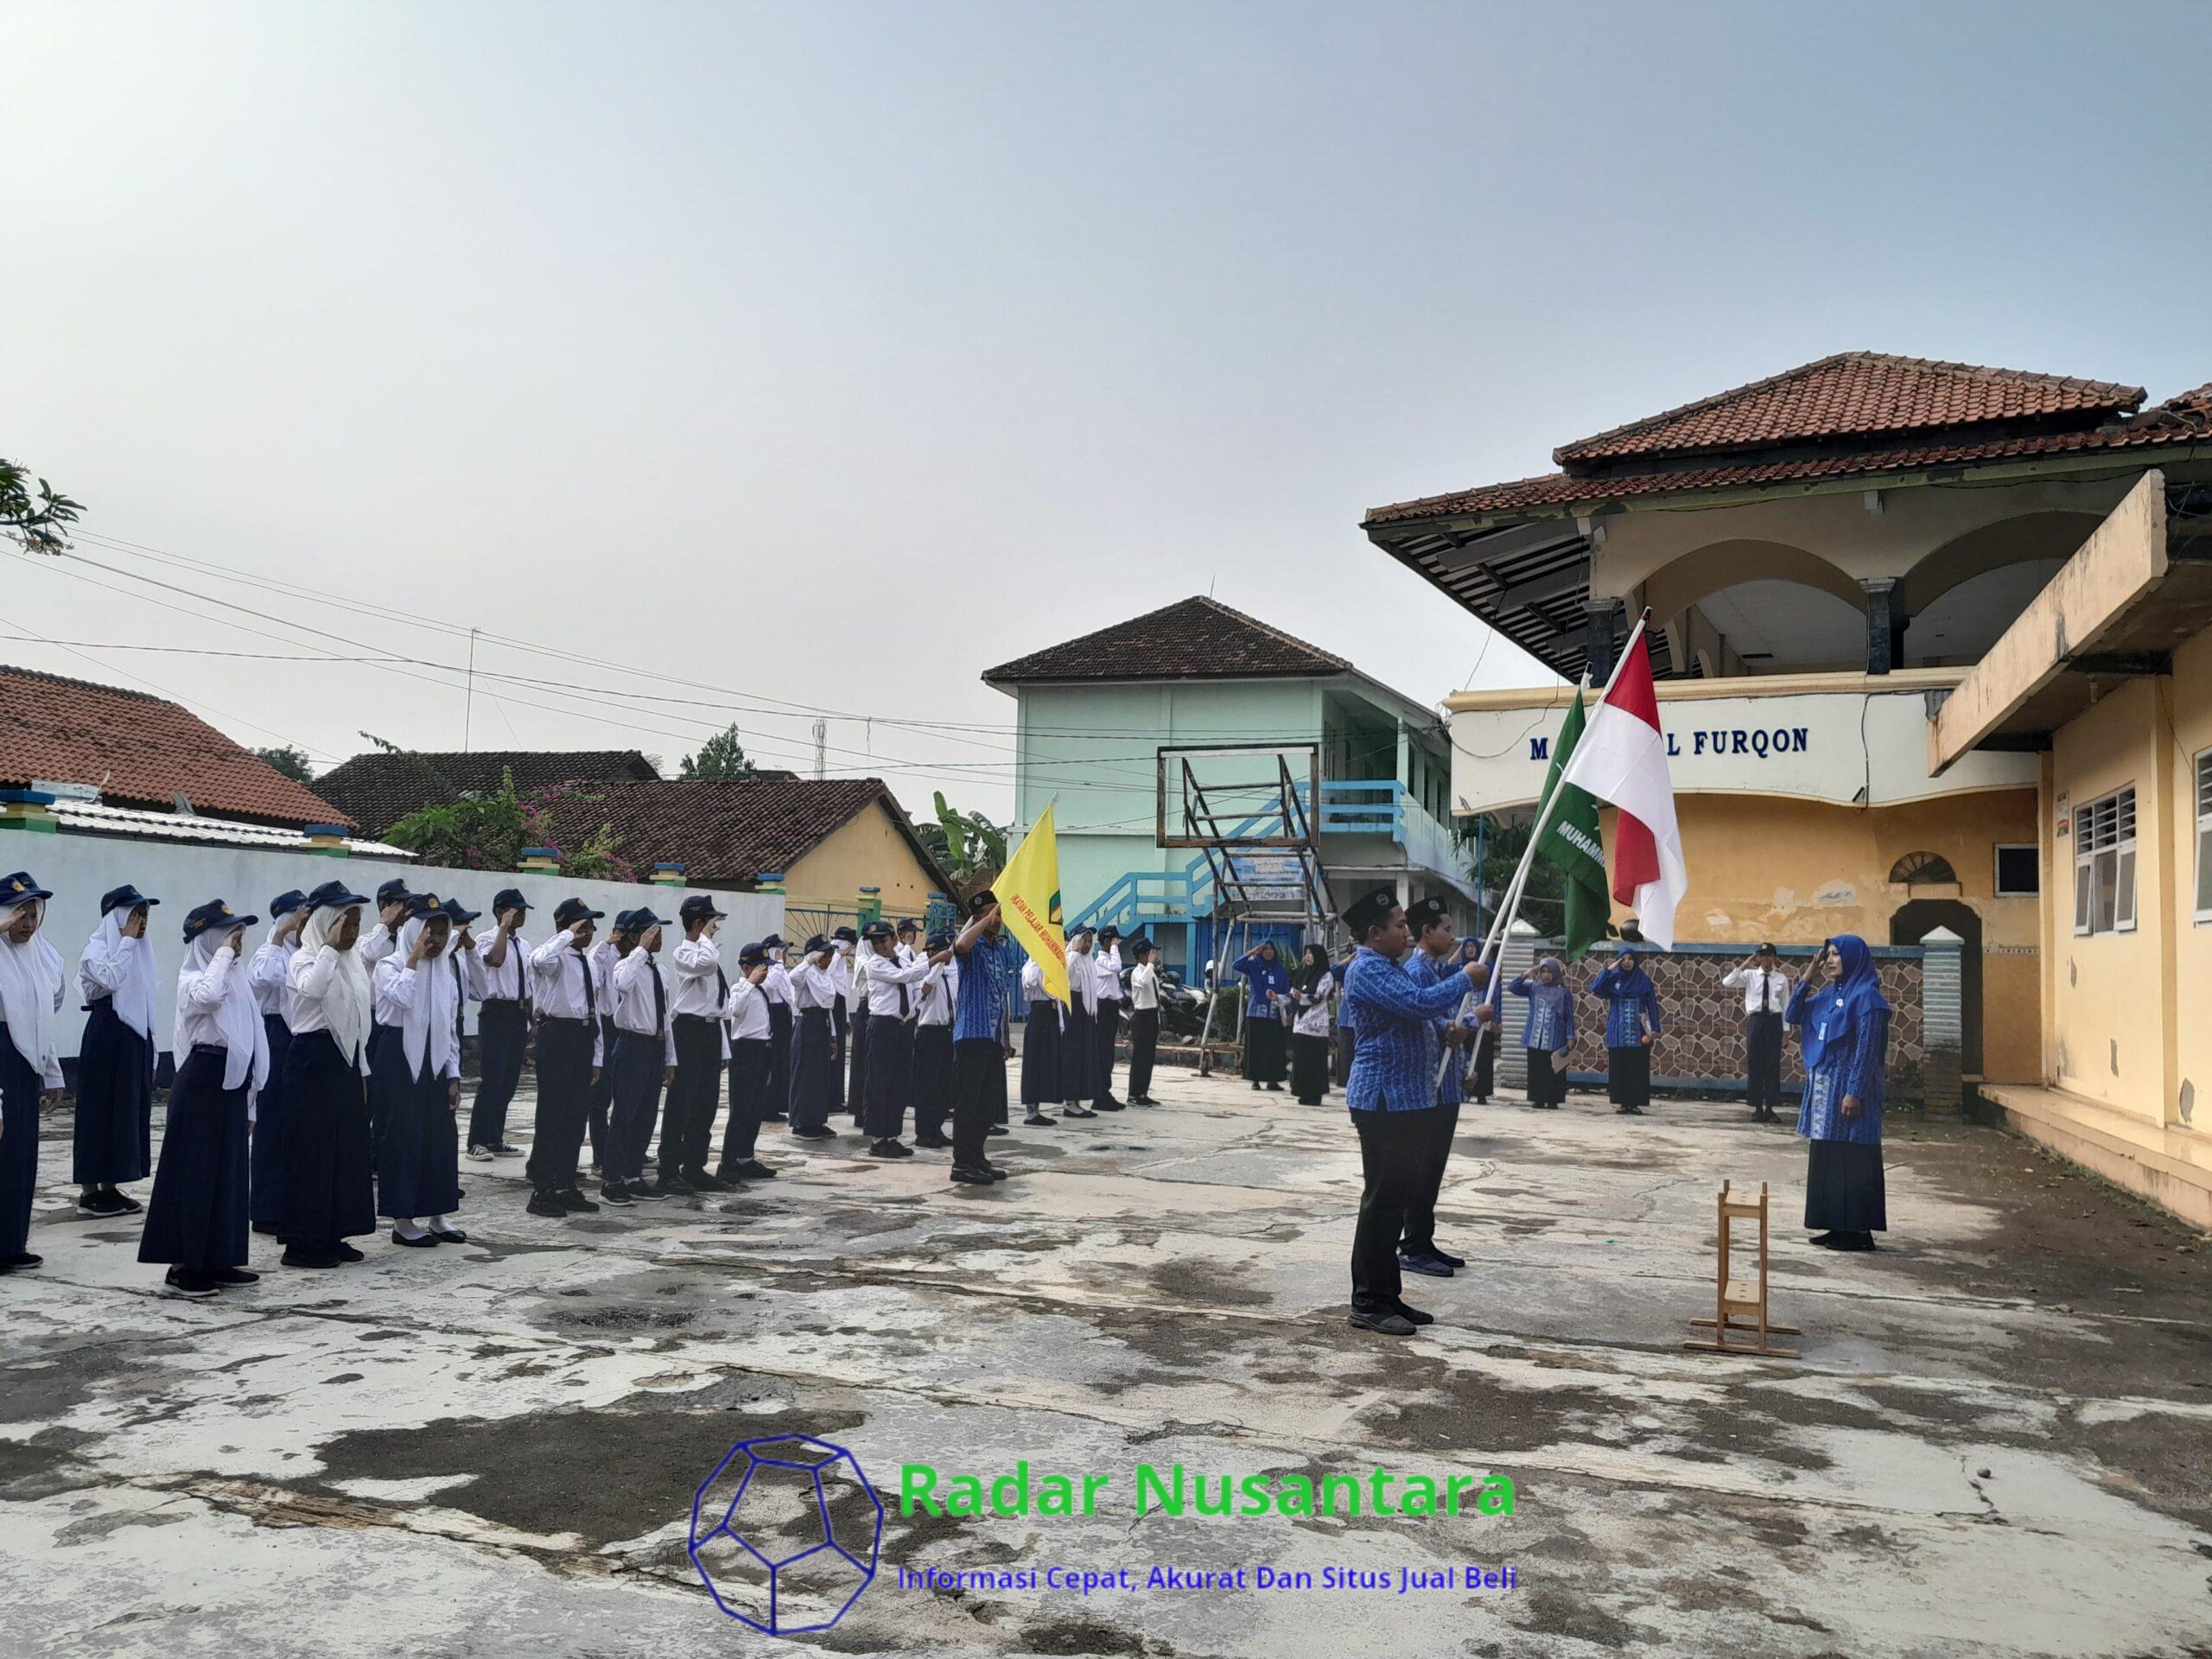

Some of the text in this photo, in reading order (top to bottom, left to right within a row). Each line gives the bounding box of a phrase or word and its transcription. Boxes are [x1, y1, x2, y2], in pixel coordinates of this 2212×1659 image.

[1693, 728, 1808, 759] FURQON
[1556, 820, 1605, 868] MUHAMM
[1024, 908, 1044, 933] PELAJAR
